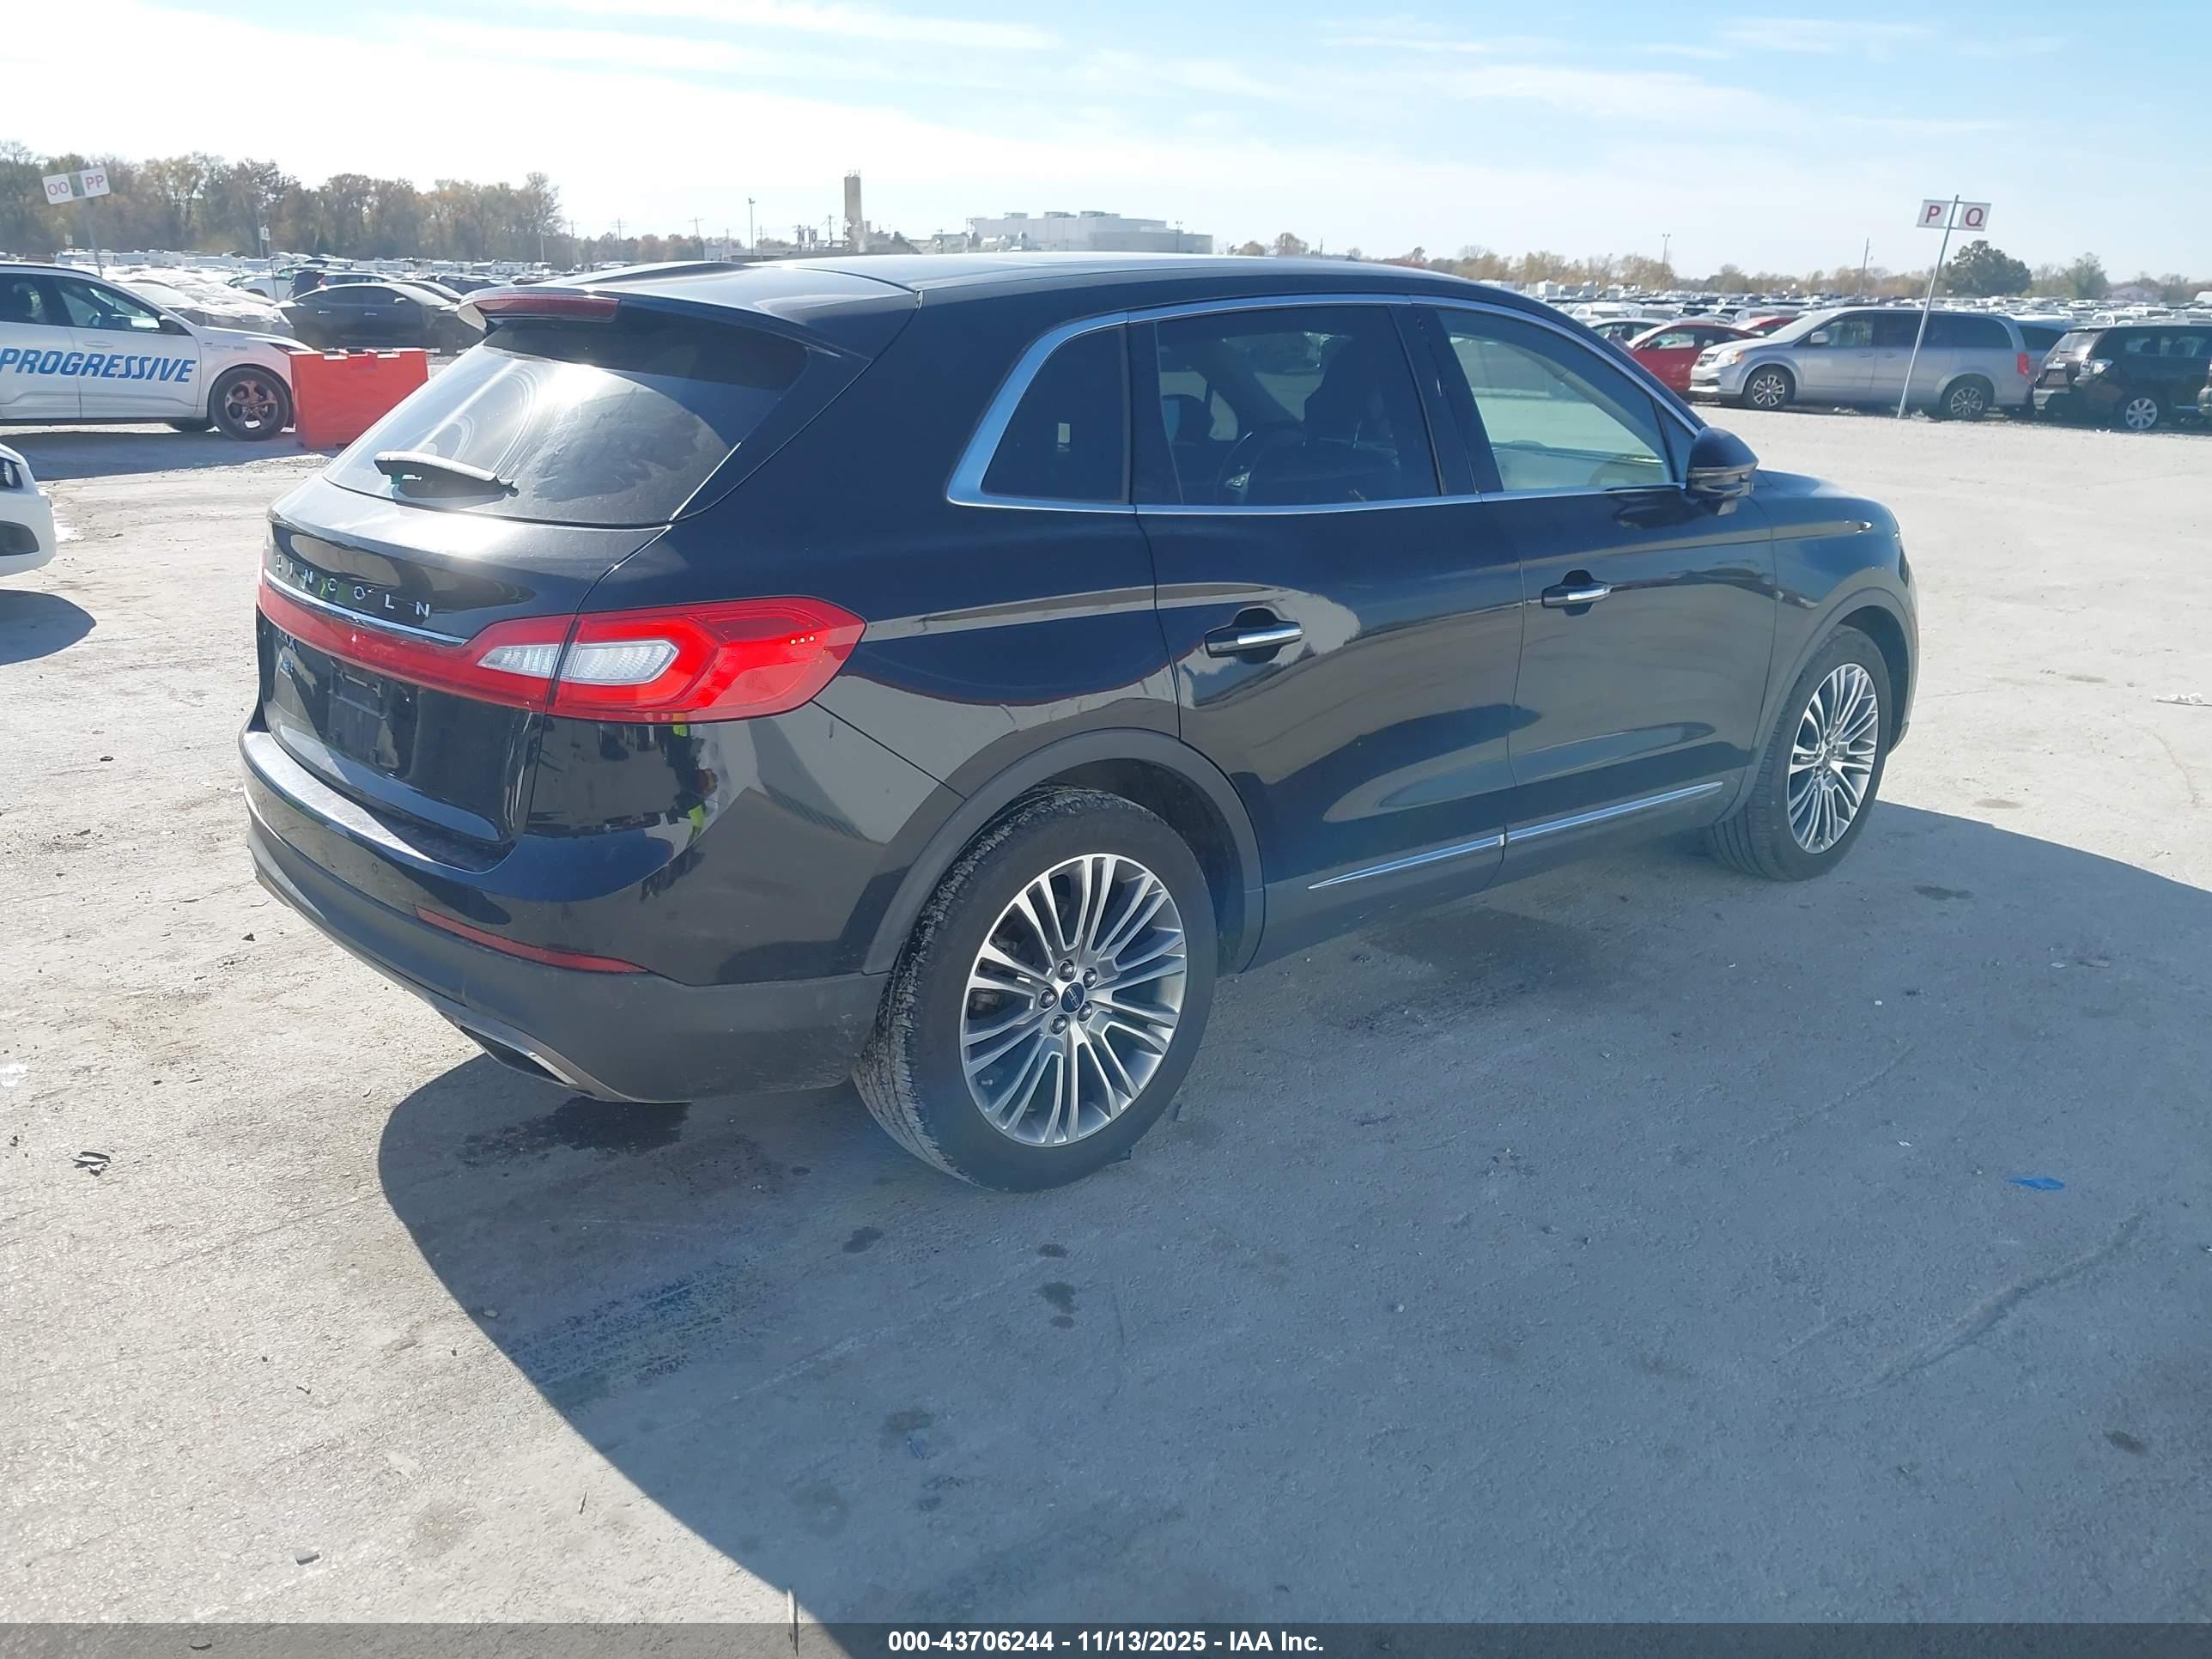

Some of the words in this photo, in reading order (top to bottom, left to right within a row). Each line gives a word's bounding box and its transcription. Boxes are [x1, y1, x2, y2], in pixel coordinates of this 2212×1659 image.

[86, 174, 104, 190] PP
[1925, 205, 1941, 223] P
[1966, 208, 1984, 227] Q
[0, 348, 197, 383] PROGRESSIVE
[276, 555, 429, 617] LINCOLN
